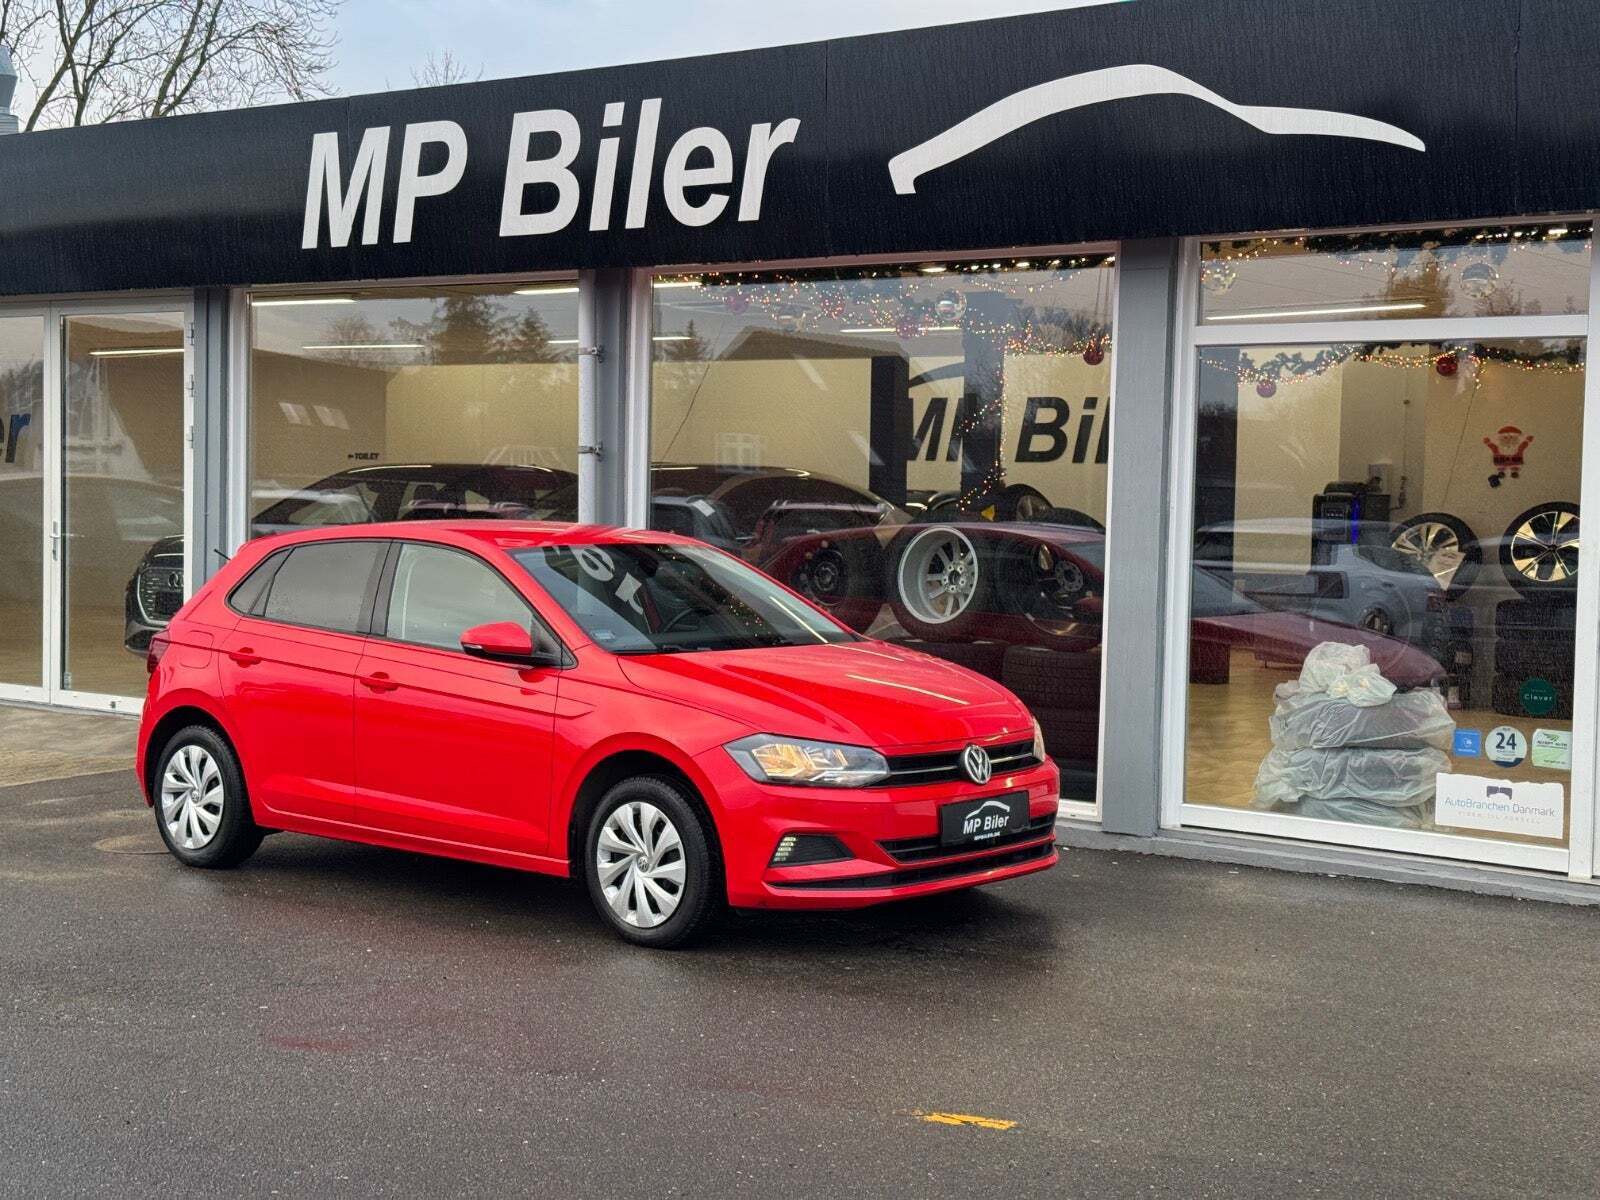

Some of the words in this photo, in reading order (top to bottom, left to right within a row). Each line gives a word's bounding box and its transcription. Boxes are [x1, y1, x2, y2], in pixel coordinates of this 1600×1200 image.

[301, 119, 468, 249] MP
[499, 97, 801, 237] Biler
[1495, 732, 1517, 750] 24
[1445, 797, 1510, 812] AutoBranchen
[1512, 803, 1555, 817] Danmark
[963, 818, 981, 834] MP
[983, 814, 1010, 831] Biler
